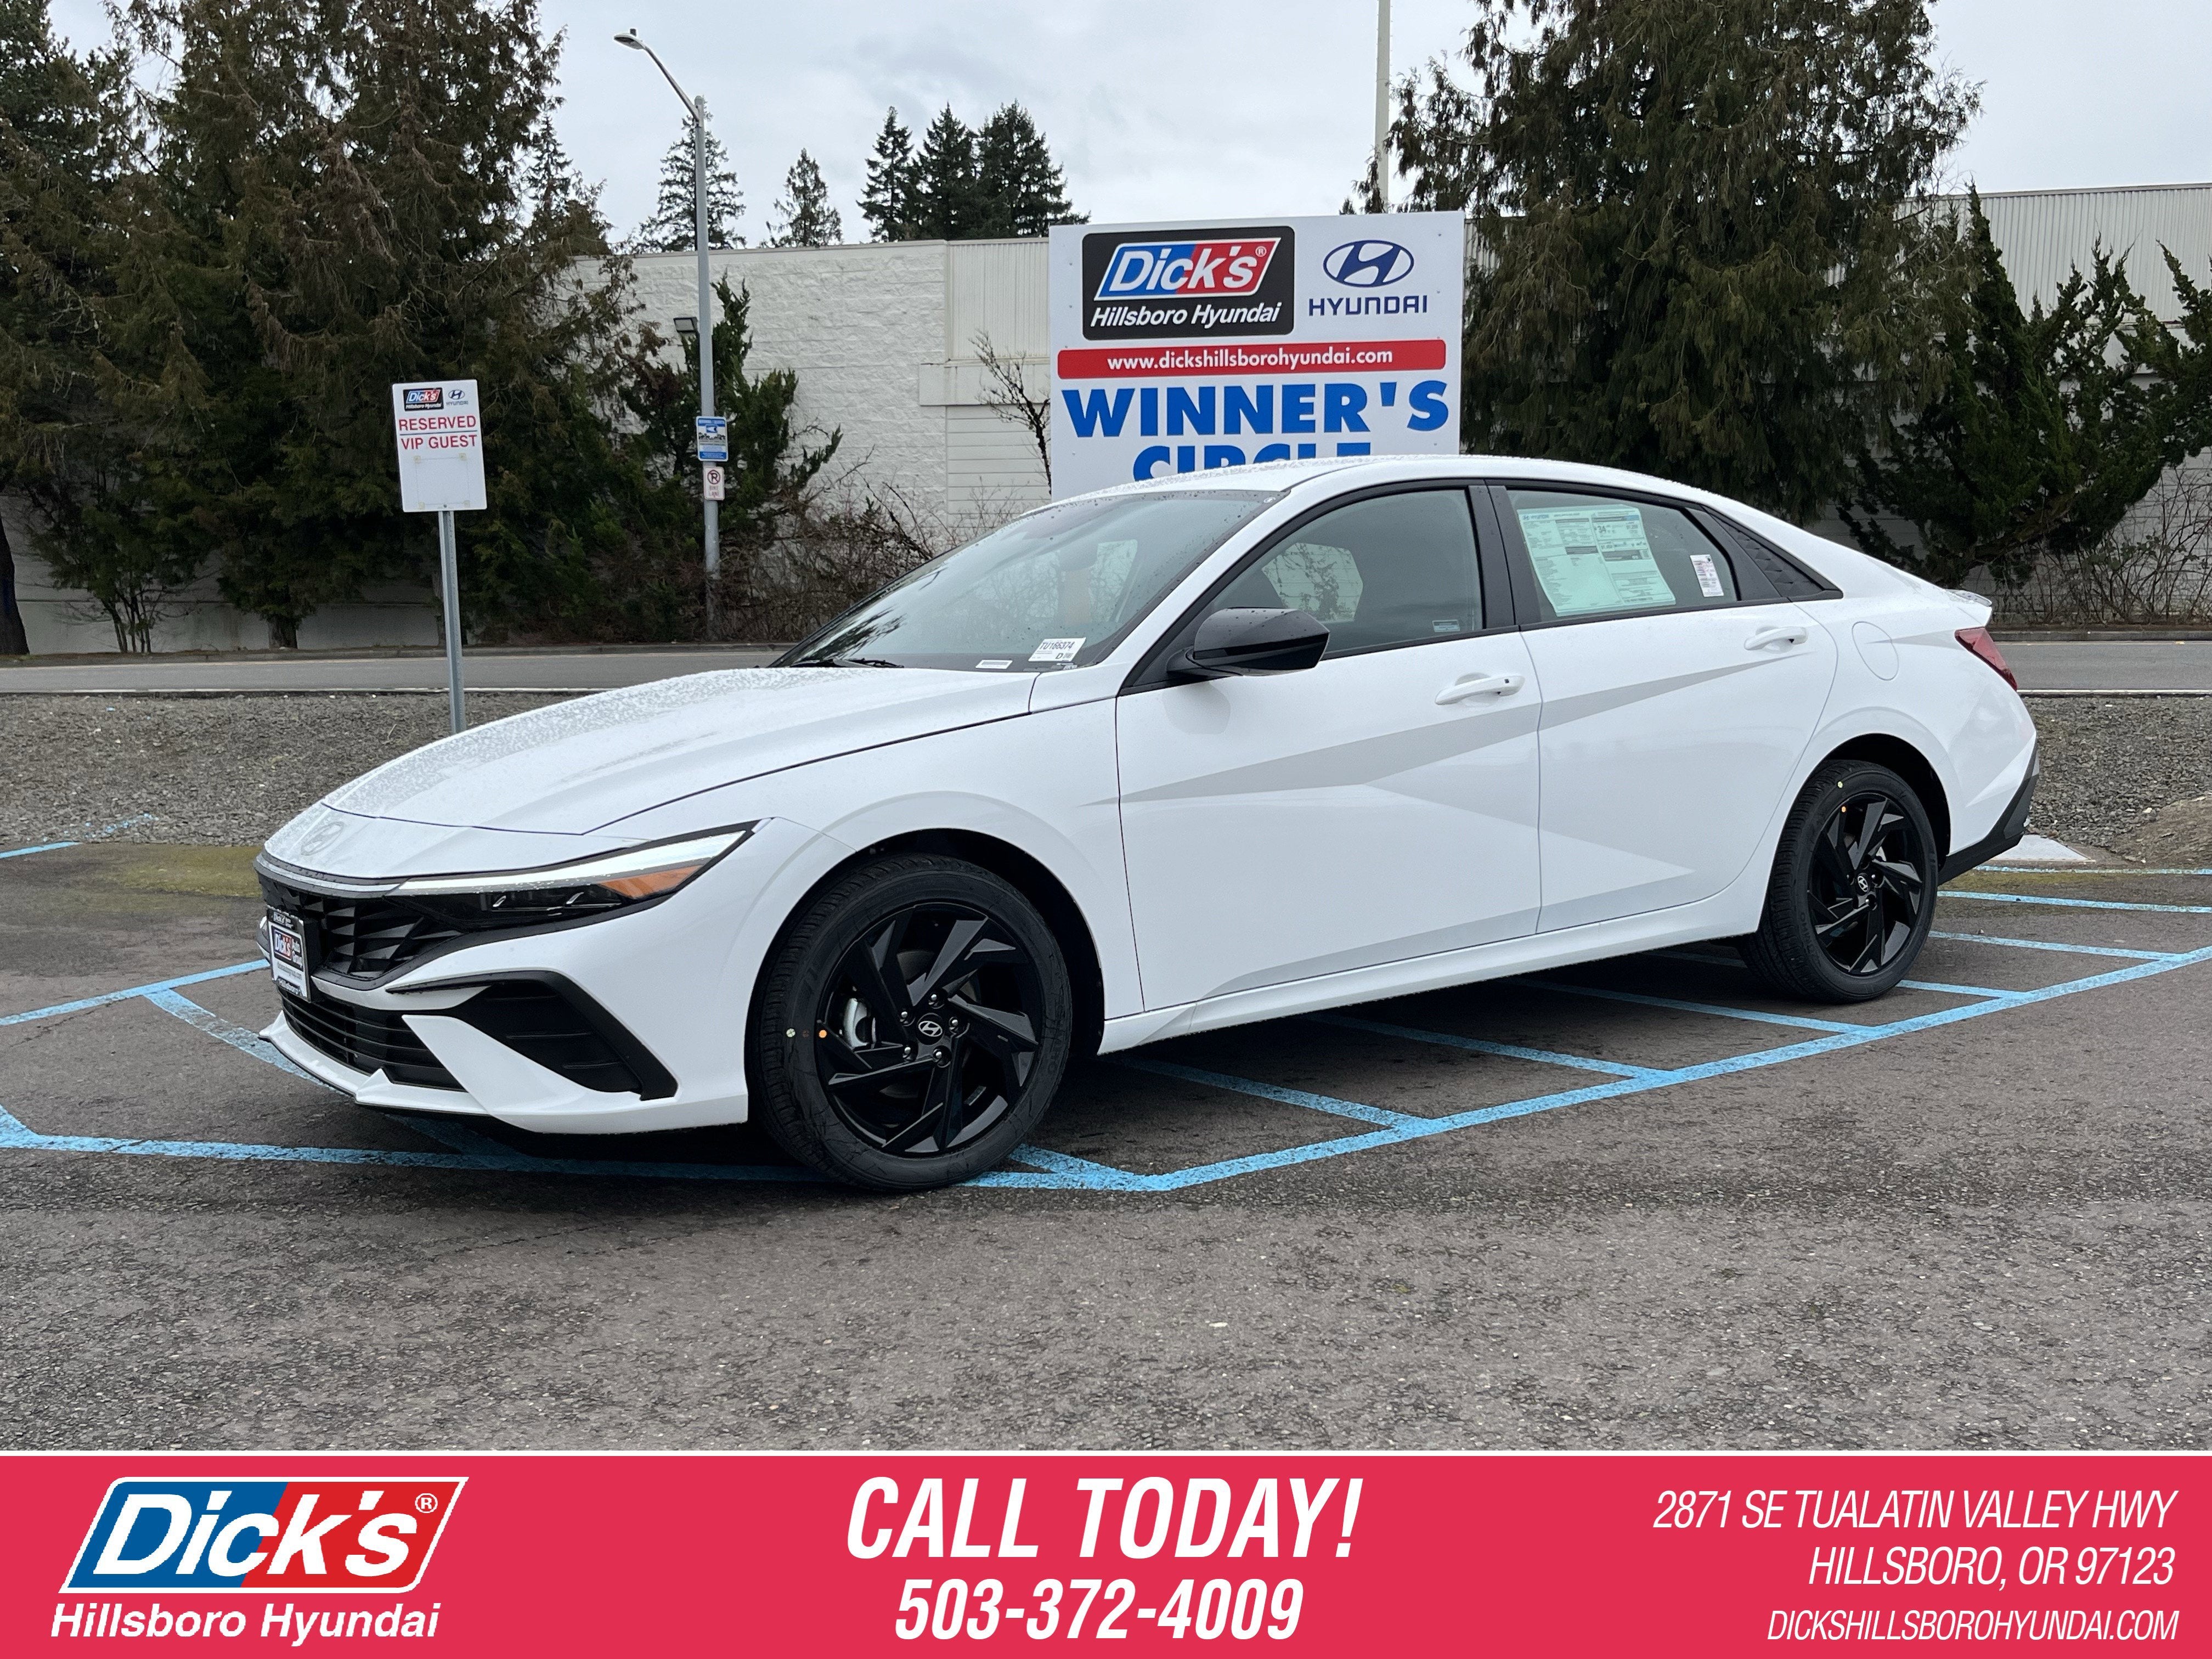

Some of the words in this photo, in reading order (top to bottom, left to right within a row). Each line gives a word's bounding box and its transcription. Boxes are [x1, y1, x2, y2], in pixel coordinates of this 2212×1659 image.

[1090, 305, 1187, 328] Hillsboro
[1191, 301, 1282, 329] Hyundai
[1308, 295, 1428, 317] HYUNDAI
[1107, 346, 1393, 371] www.dickshillsborohyundai.com
[1062, 380, 1449, 437] WINNER'S
[398, 415, 476, 431] RESERVED
[400, 437, 424, 450] VIP
[428, 435, 478, 449] GUEST
